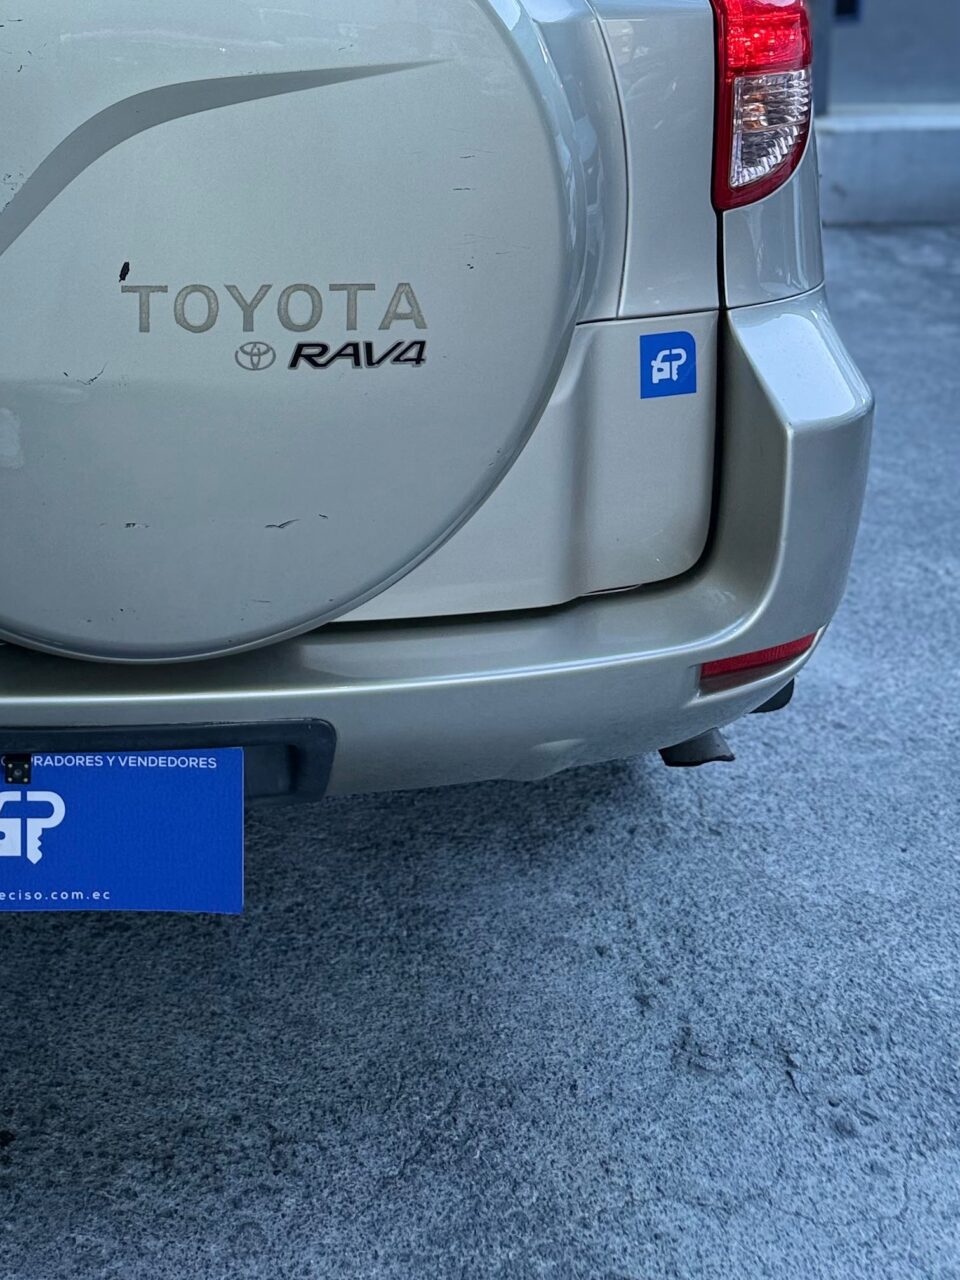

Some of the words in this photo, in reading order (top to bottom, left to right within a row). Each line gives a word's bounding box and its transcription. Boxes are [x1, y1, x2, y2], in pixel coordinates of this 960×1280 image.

[121, 282, 428, 334] TOYOTA
[287, 339, 427, 370] RAV4
[106, 755, 116, 767] Y
[117, 755, 218, 769] VENDEDORES
